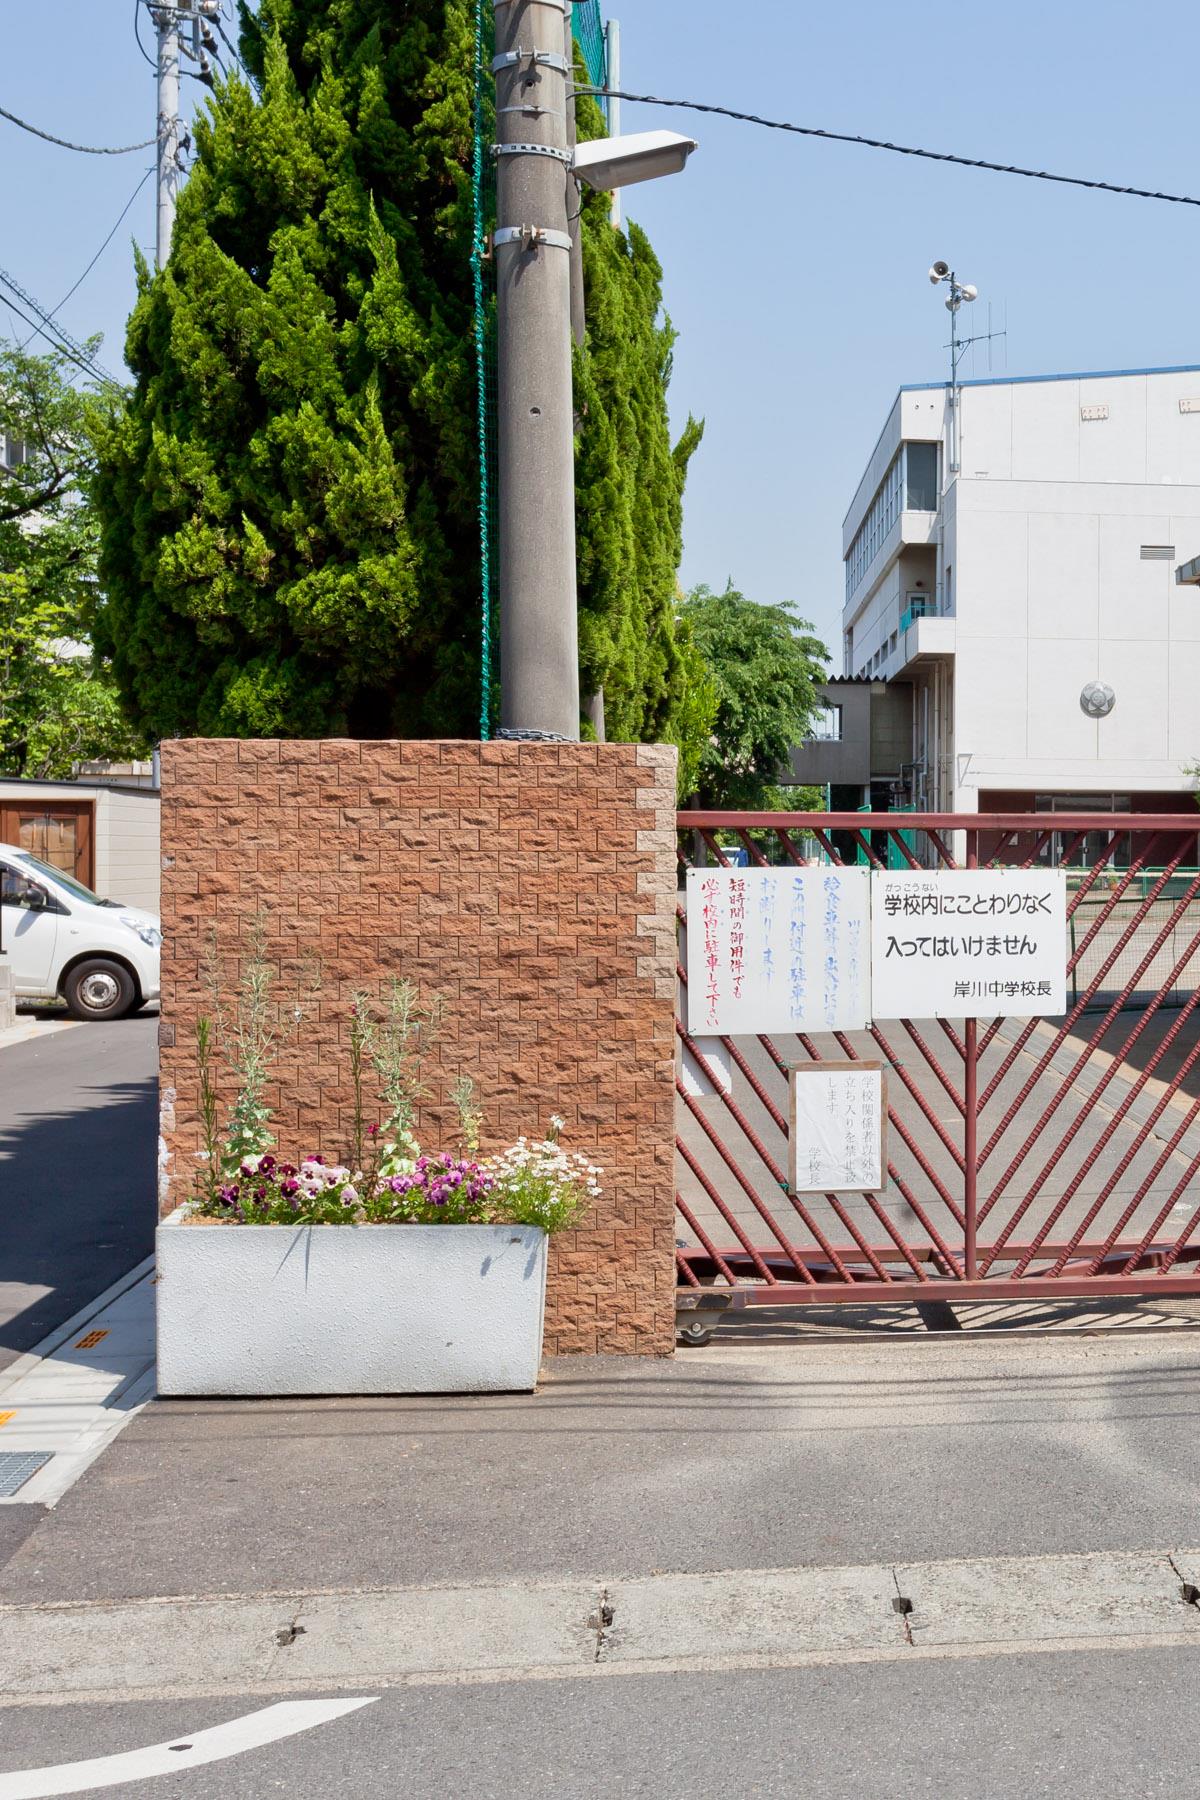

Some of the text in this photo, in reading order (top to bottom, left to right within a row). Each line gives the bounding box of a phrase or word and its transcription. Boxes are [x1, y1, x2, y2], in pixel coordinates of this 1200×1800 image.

[885, 892, 1052, 916] 学校内にことわりなく
[701, 878, 721, 1026] 必ず校内に駐車して下さい
[729, 878, 746, 999] 短時間の御用件でも
[885, 935, 1037, 958] 入ってはいけません
[953, 980, 1052, 998] 岸川中学校長
[861, 1075, 875, 1183] 学校関係者以外の
[808, 1146, 821, 1185] 学校長
